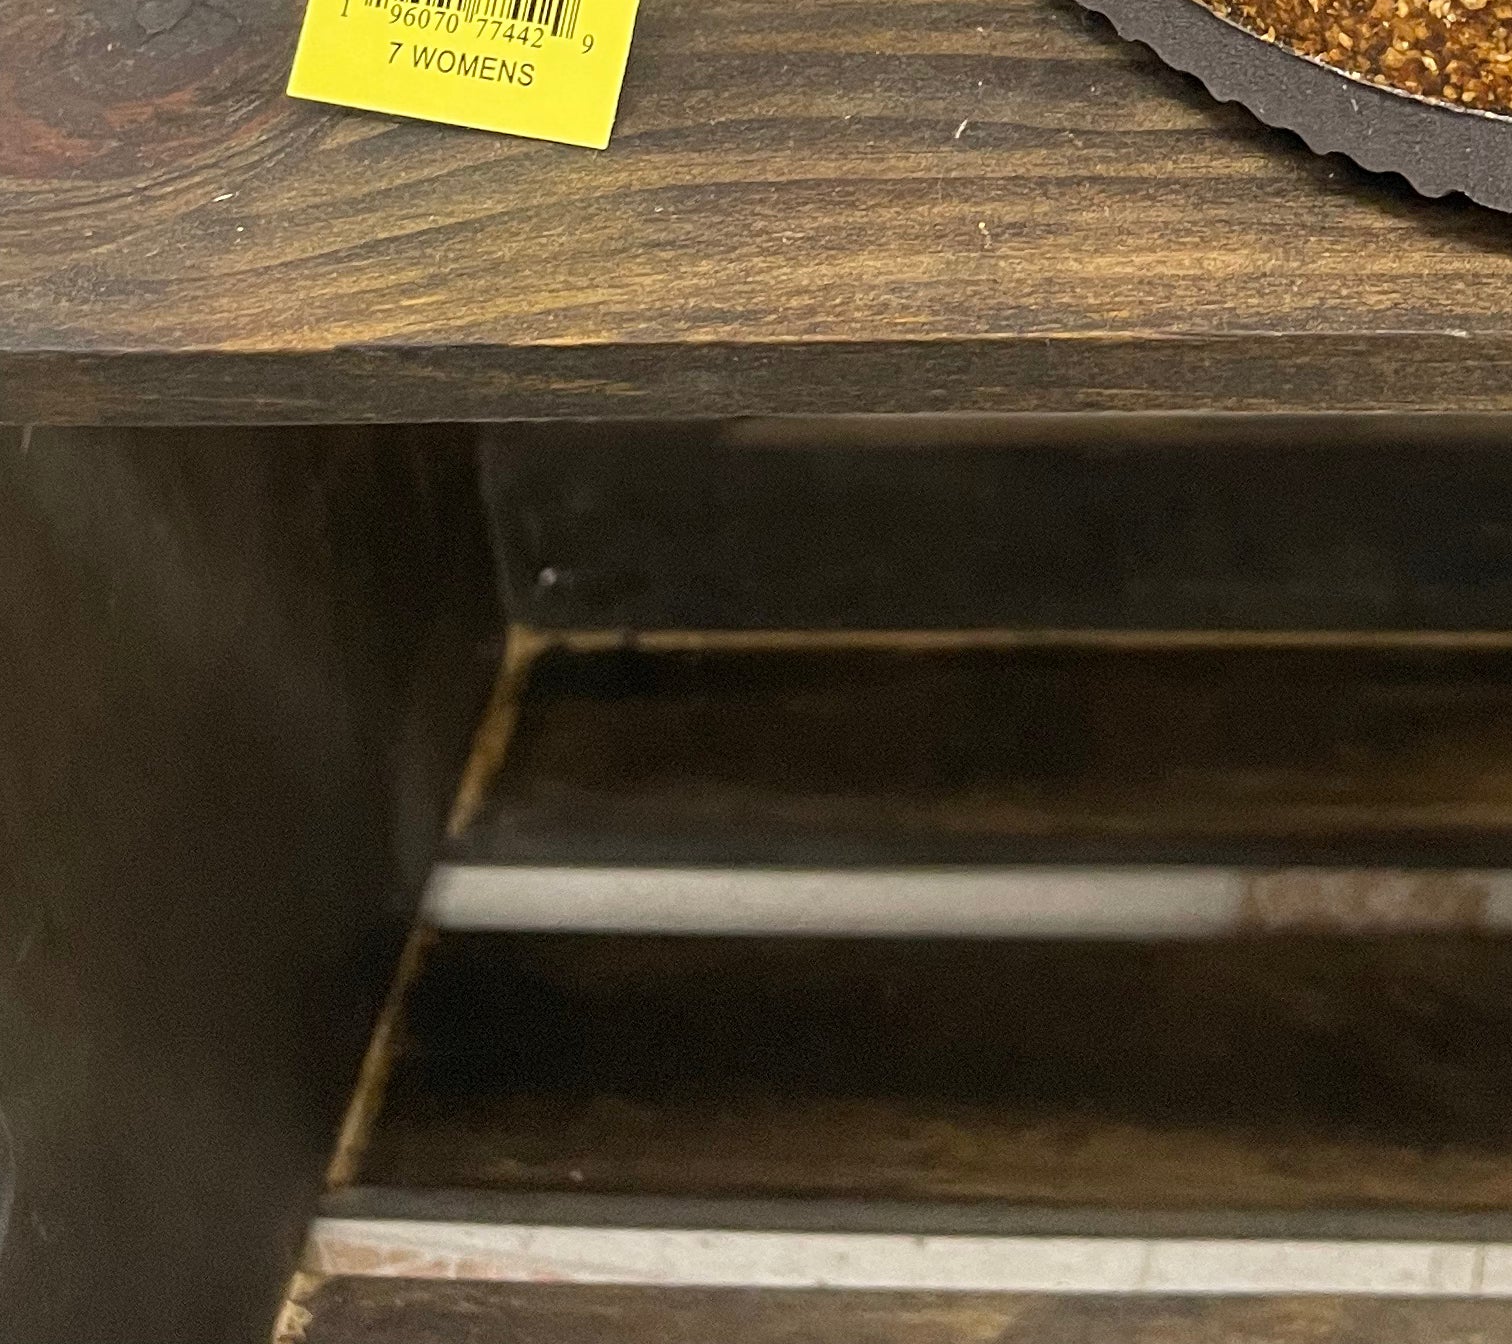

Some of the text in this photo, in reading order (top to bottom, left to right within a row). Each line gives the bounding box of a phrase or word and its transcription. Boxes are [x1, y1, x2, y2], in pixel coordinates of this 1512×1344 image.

[389, 4, 459, 34] 96070
[475, 18, 545, 49] 77442
[581, 33, 595, 55] 9
[388, 41, 535, 87] 7 WOMENS
